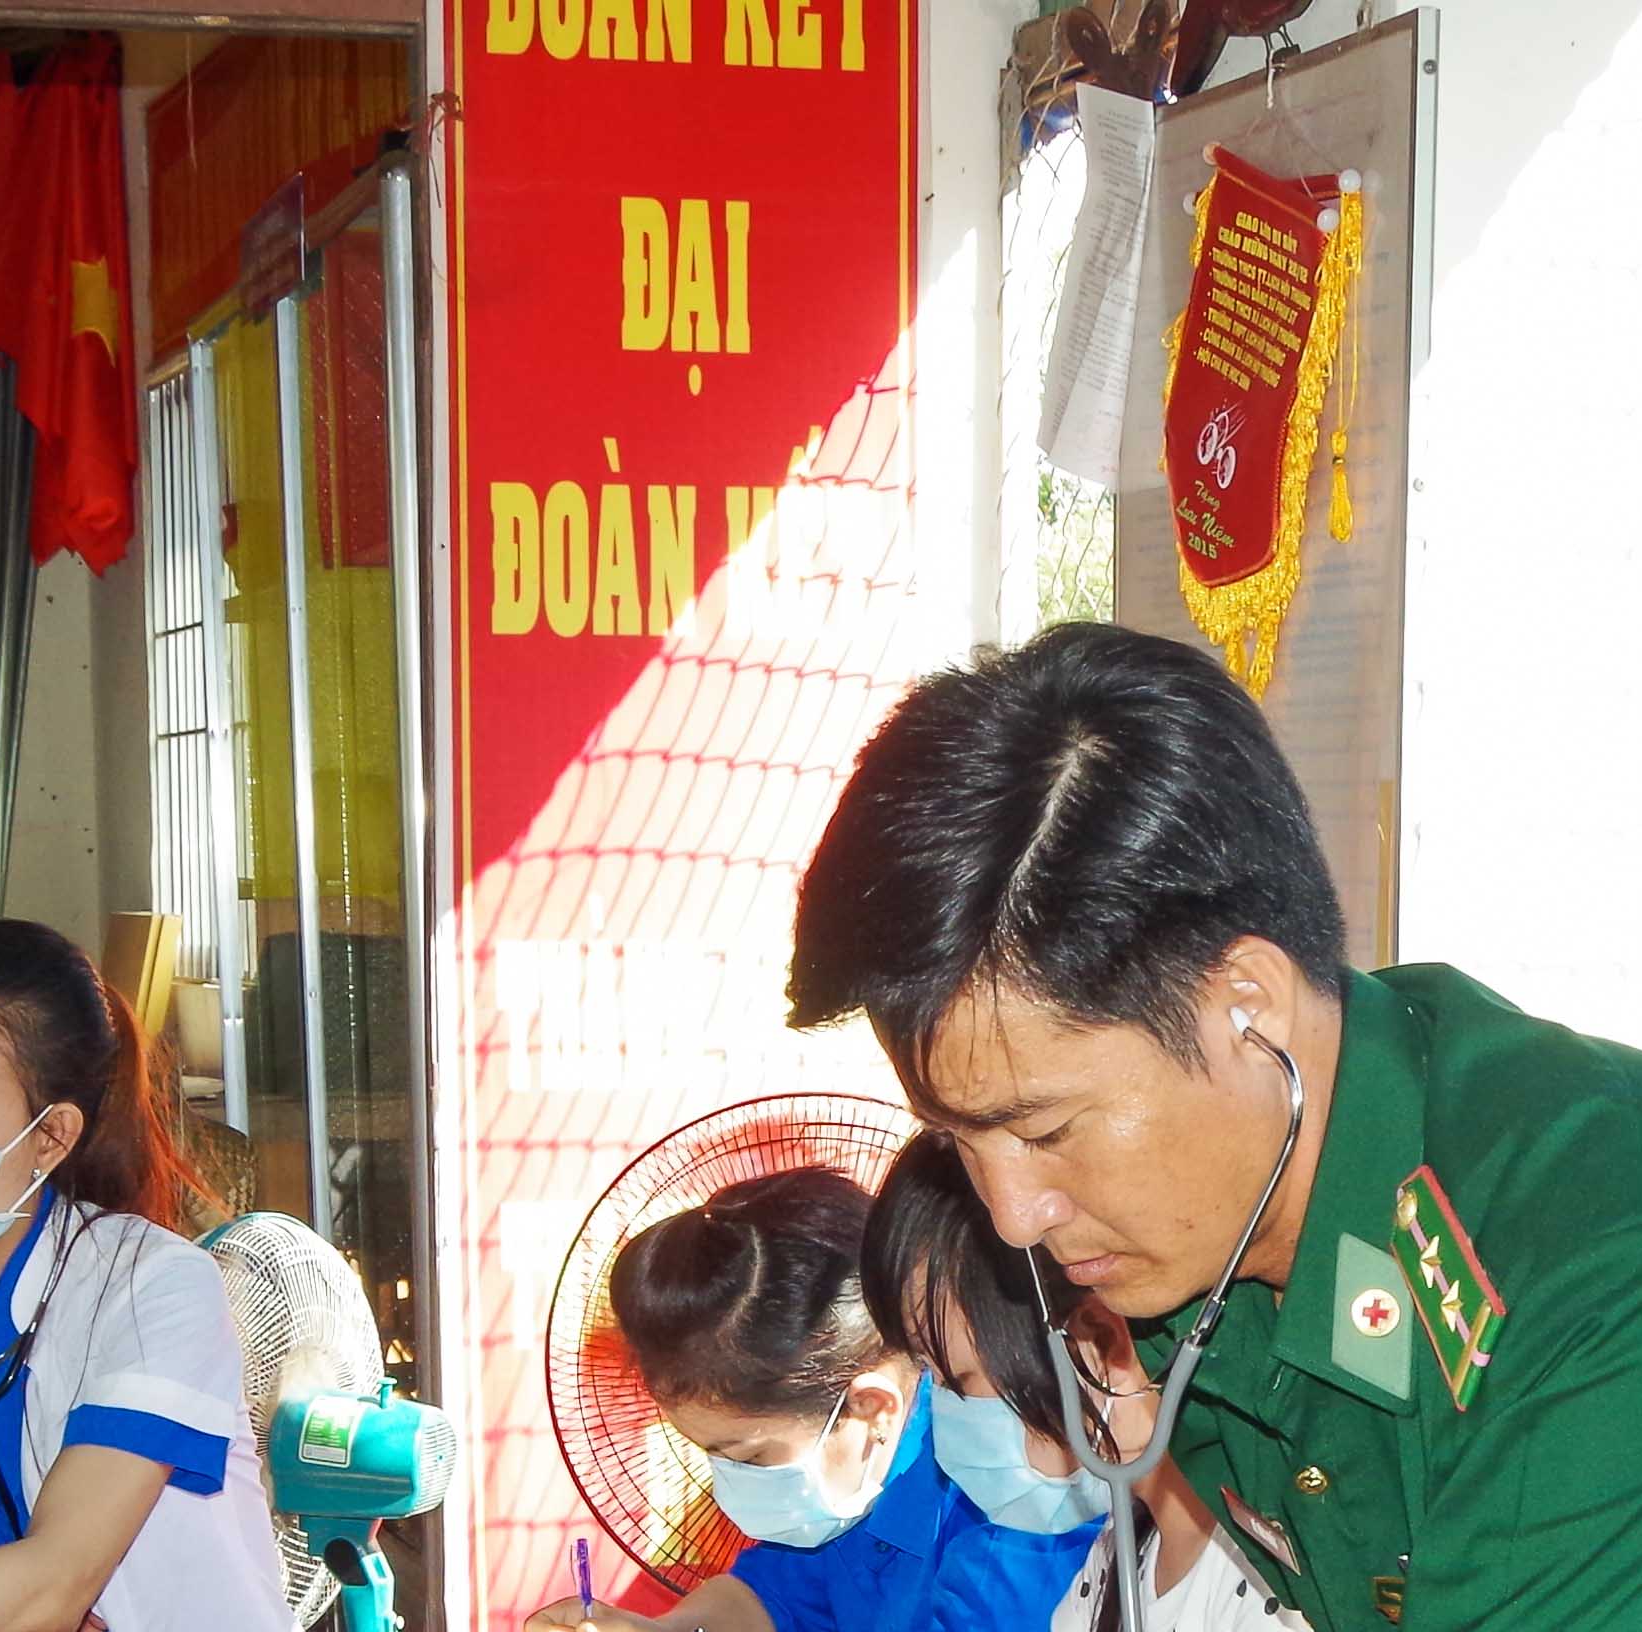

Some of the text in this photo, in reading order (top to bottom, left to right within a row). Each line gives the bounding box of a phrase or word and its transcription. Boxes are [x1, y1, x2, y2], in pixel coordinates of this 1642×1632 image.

[620, 196, 751, 396] ĐẠI
[489, 437, 697, 638] ĐOÀN
[1188, 532, 1217, 560] 2015
